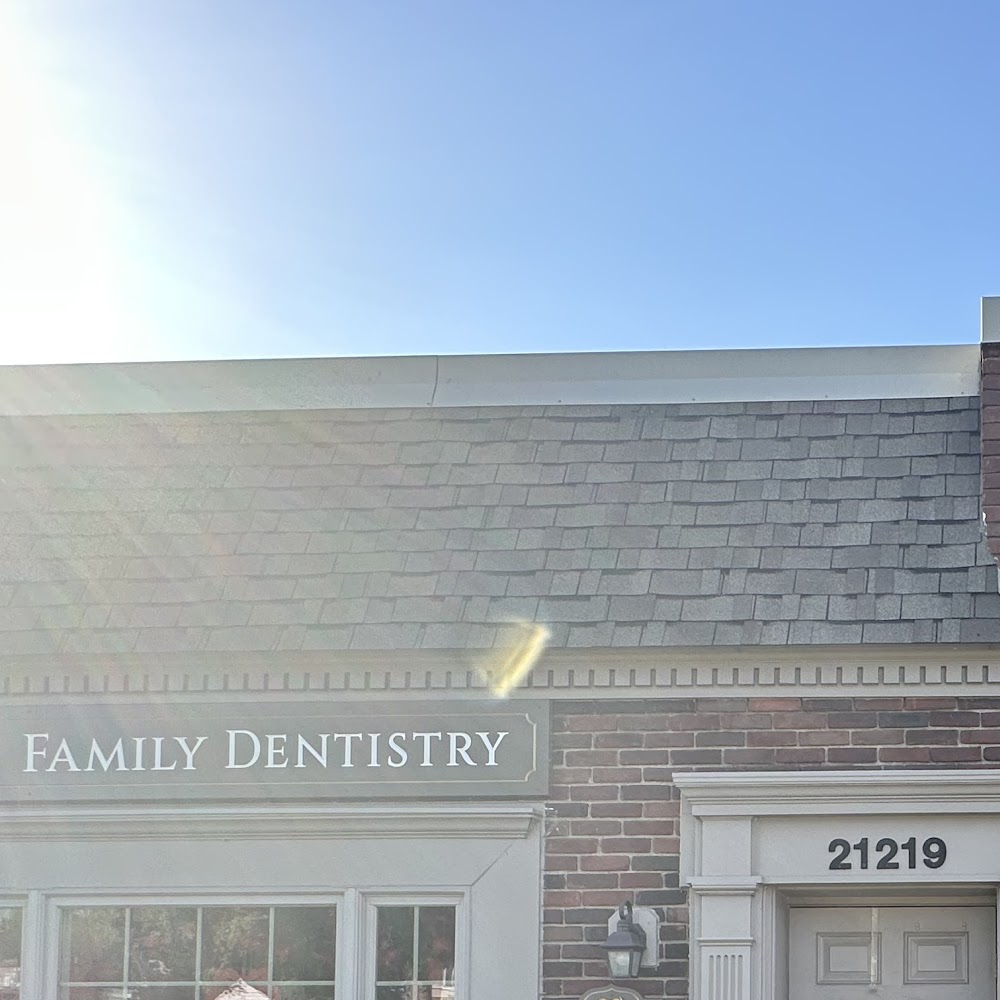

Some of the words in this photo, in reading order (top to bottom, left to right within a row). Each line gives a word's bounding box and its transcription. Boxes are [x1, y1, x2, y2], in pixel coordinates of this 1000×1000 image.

[22, 733, 209, 773] FAMILY
[224, 729, 510, 770] DENTISTRY
[828, 836, 948, 871] 21219
